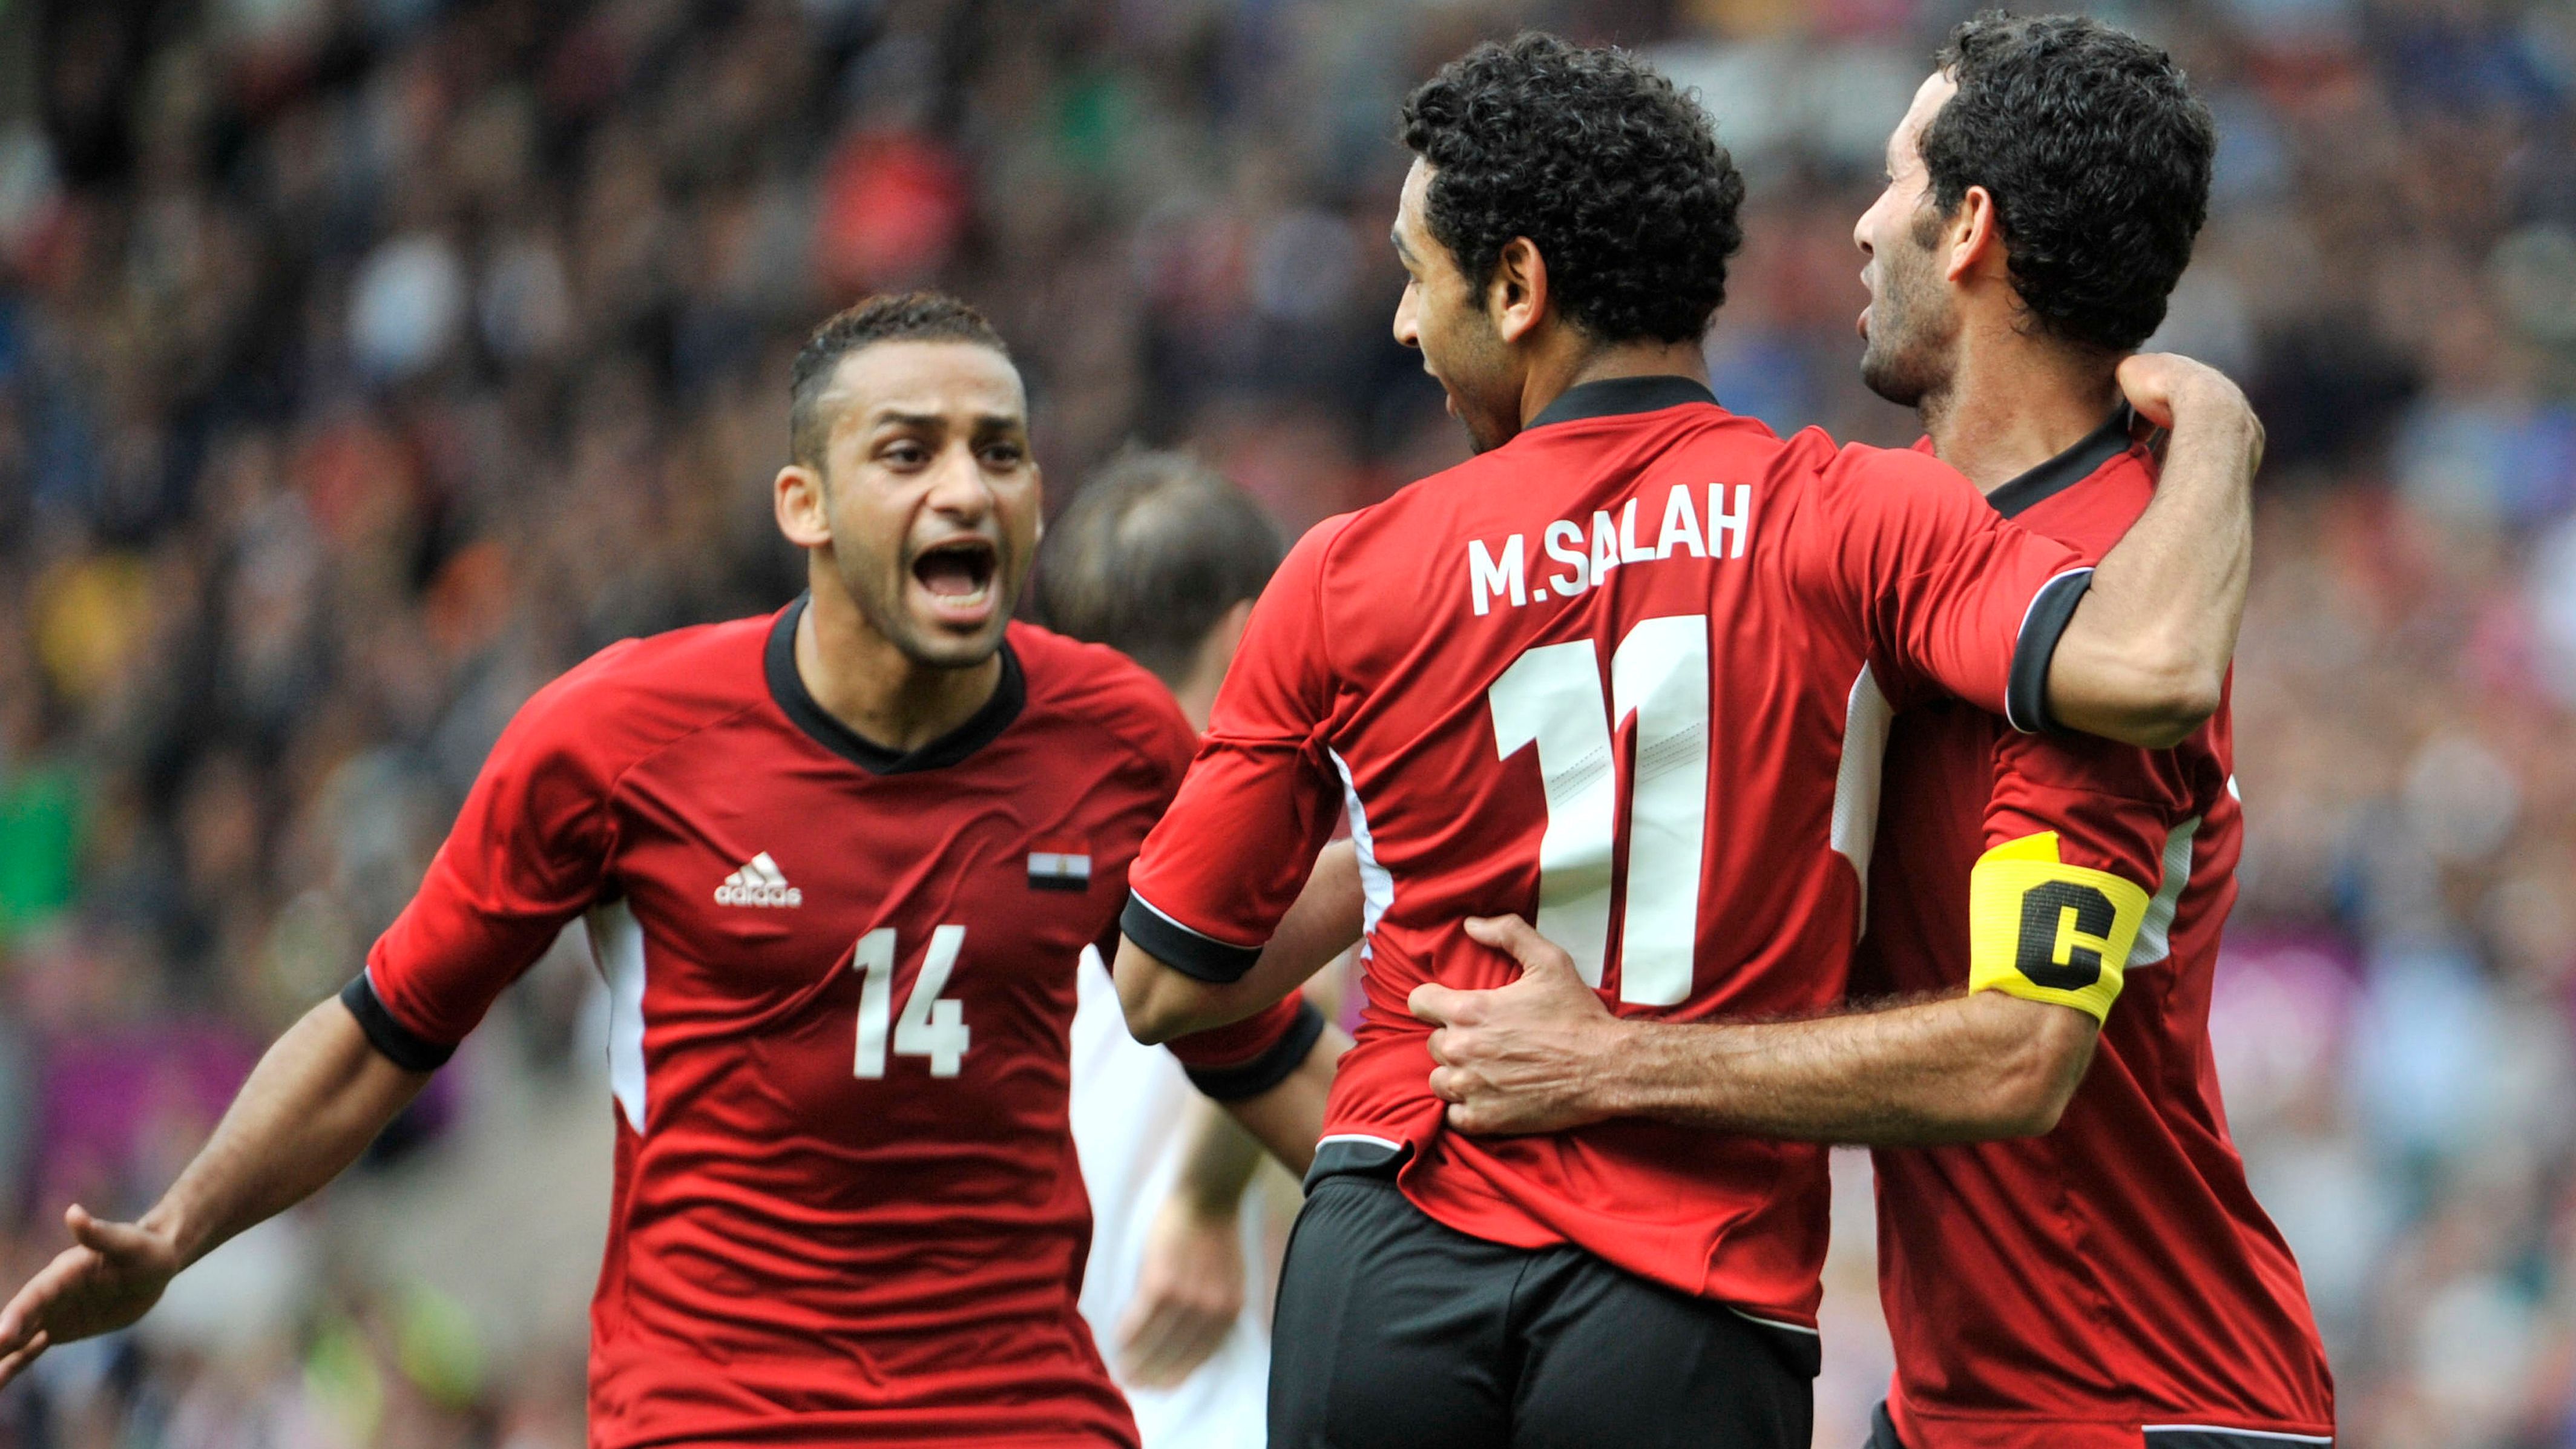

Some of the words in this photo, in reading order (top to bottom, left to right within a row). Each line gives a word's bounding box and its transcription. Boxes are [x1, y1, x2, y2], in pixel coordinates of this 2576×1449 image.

[1468, 483, 1751, 616] M.SALAH
[1488, 614, 1709, 1007] 11
[714, 884, 802, 907] adidas
[2015, 880, 2116, 991] C
[853, 924, 970, 1079] 14
